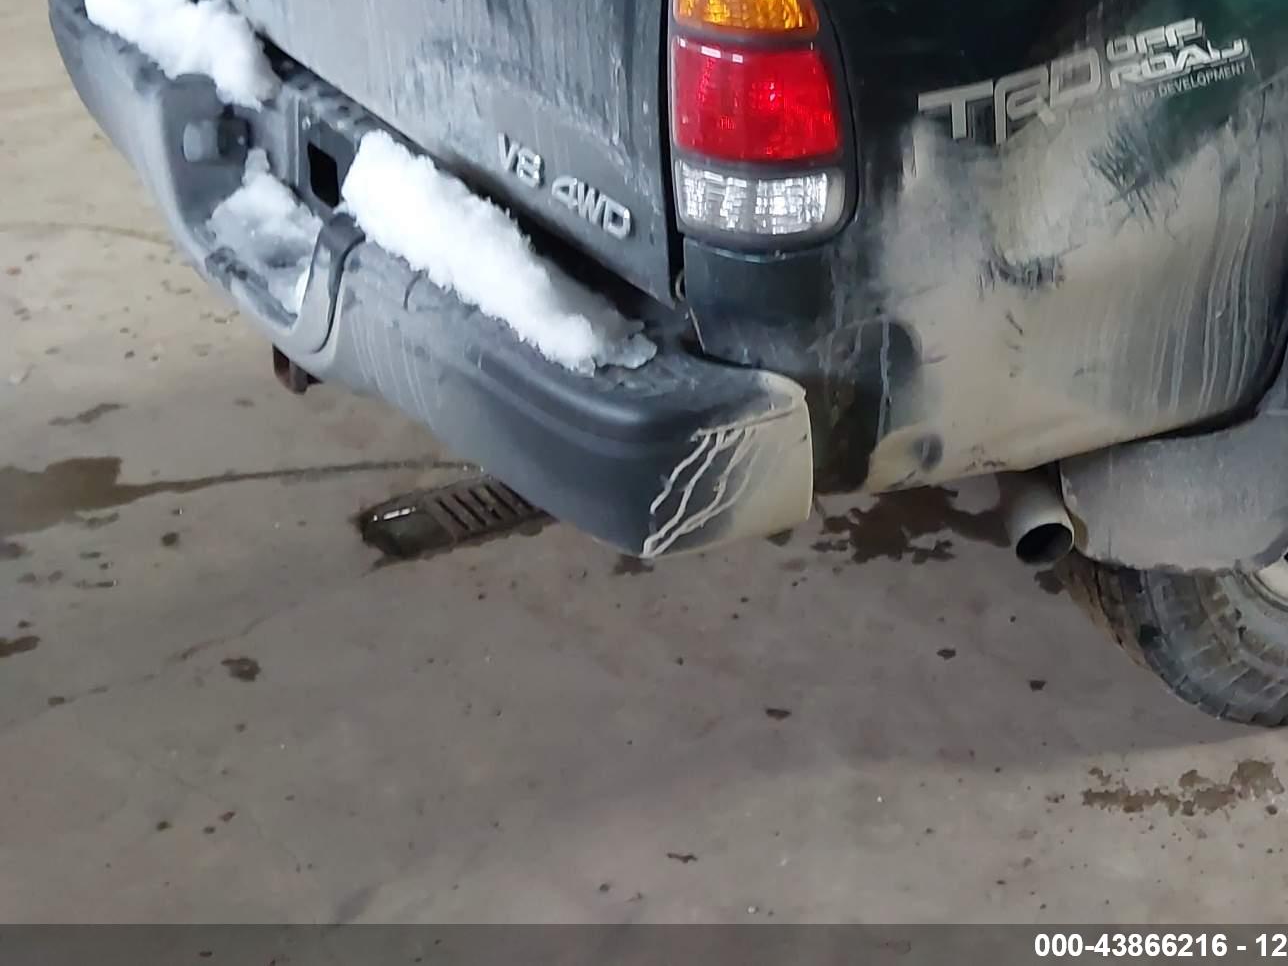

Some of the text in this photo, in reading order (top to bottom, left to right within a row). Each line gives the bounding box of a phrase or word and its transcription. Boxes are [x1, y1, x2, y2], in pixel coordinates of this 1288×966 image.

[1106, 17, 1202, 61] OFF
[917, 46, 1101, 145] TRD
[1158, 60, 1247, 99] DEVELOPMENT
[497, 132, 634, 240] V8 4WD
